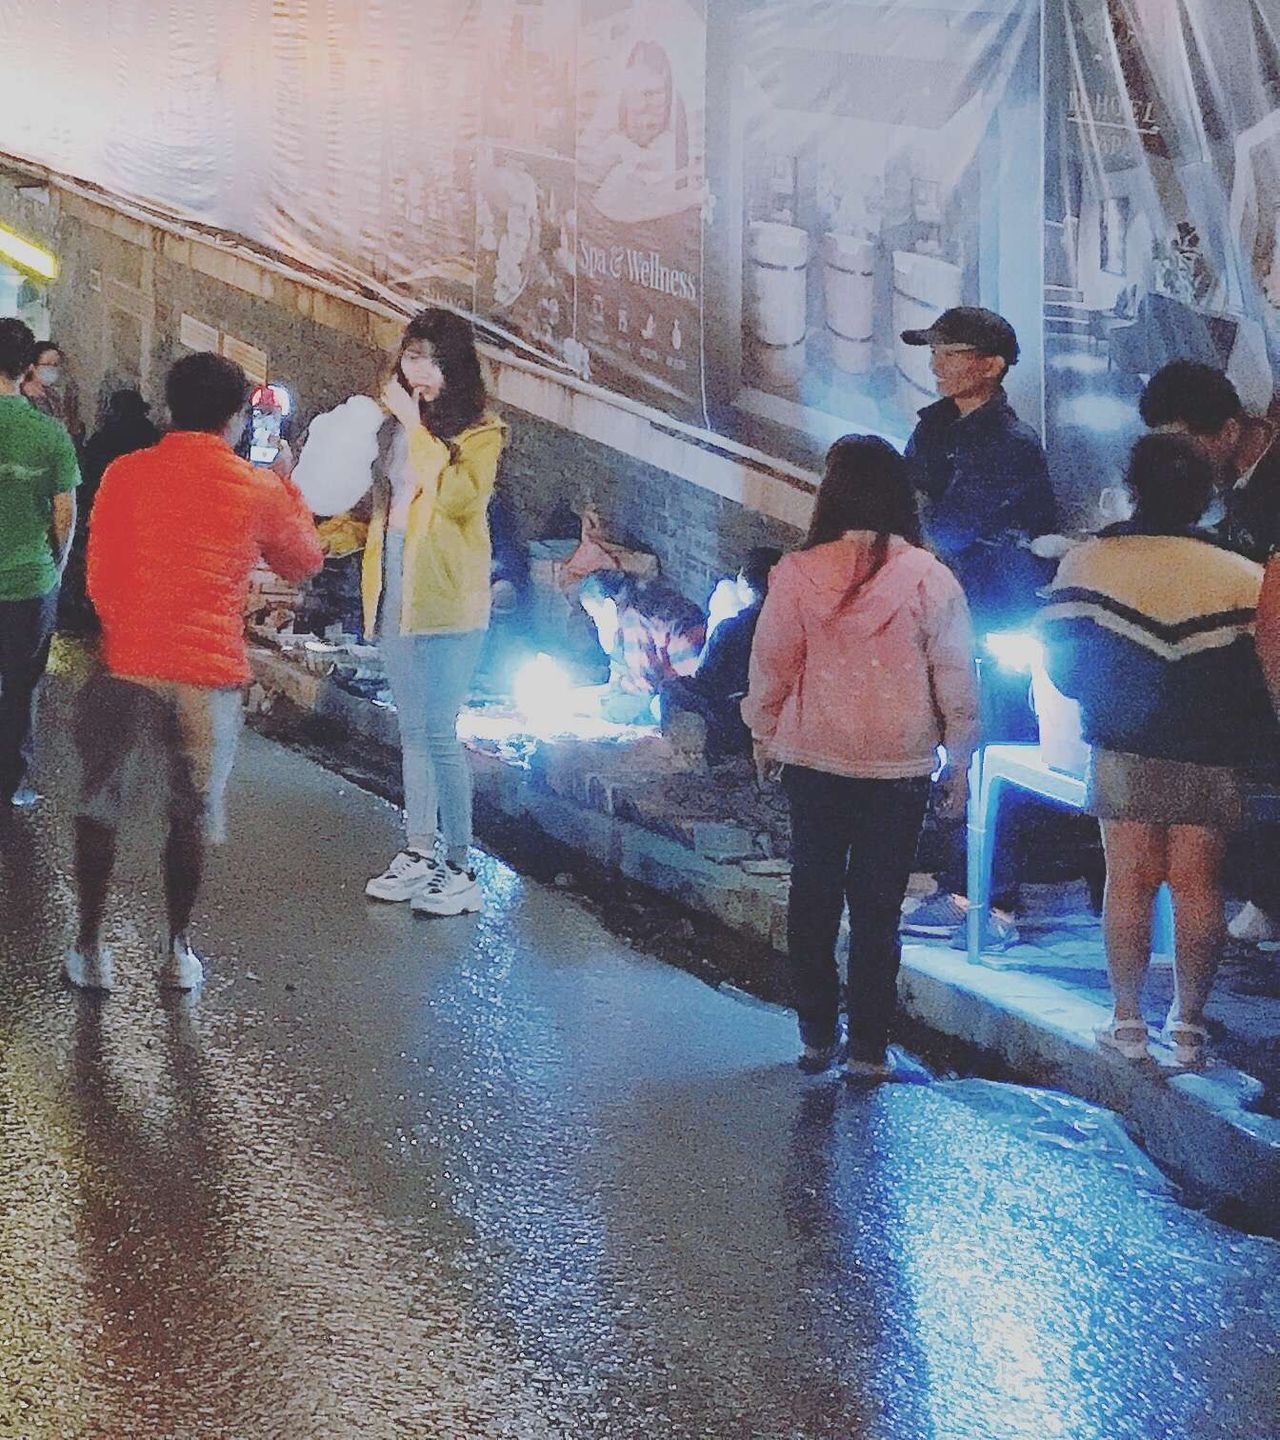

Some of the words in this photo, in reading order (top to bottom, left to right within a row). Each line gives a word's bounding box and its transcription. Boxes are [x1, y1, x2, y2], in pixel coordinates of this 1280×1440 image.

[579, 239, 607, 279] Spa
[609, 244, 625, 279] &
[625, 249, 697, 300] Wellness
